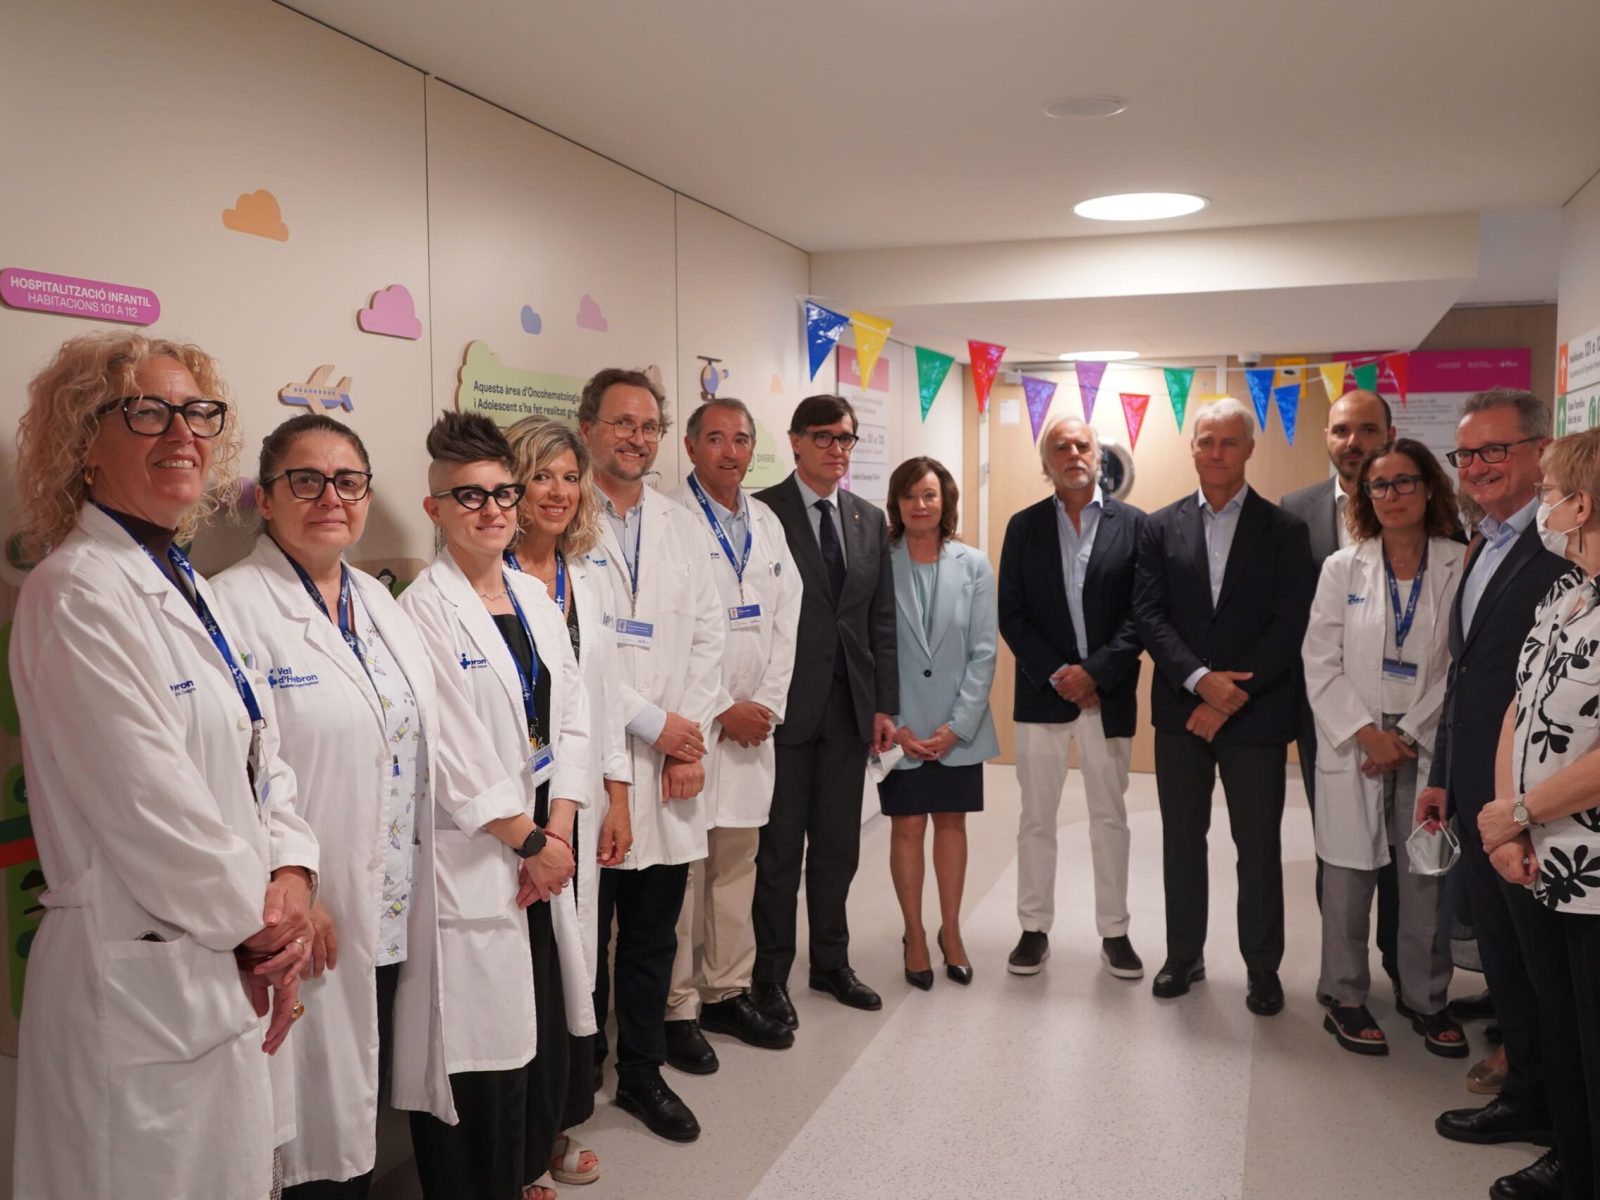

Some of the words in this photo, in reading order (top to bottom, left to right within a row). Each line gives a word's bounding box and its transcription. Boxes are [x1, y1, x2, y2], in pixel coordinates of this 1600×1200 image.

[10, 275, 106, 300] HOSPITALITZACIÓ
[108, 291, 152, 308] INFANTIL
[27, 292, 99, 312] HABITACIONS
[100, 302, 115, 314] 101
[116, 305, 124, 315] A
[125, 306, 138, 318] 112
[473, 380, 503, 395] Aquesta
[478, 398, 517, 412] Adolescent
